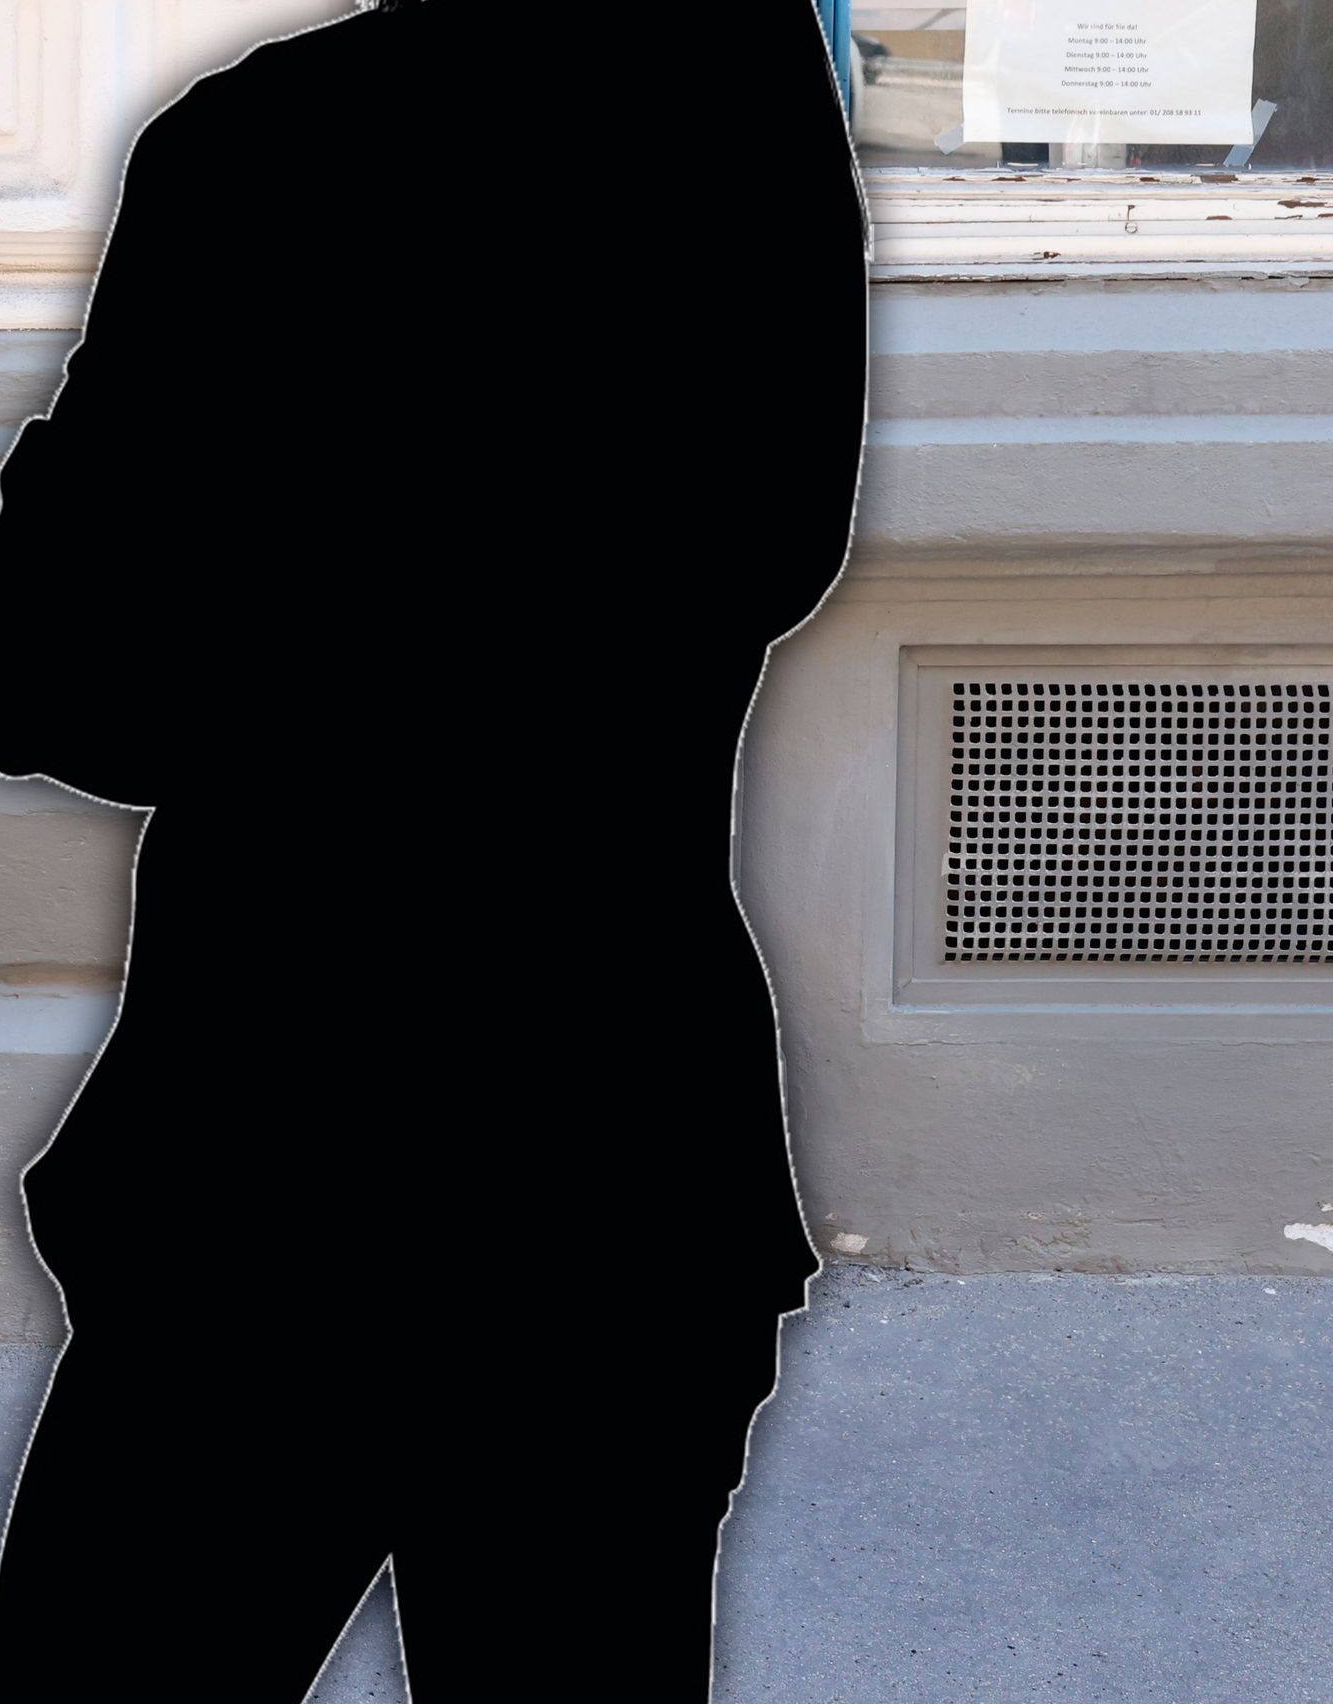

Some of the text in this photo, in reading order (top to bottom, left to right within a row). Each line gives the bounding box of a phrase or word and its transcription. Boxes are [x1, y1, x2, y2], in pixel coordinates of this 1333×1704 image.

[1068, 37, 1093, 46] Montag
[1066, 51, 1094, 60] Dienstag
[1064, 65, 1096, 73] Mittwoch
[1061, 80, 1098, 88] Donnerstag
